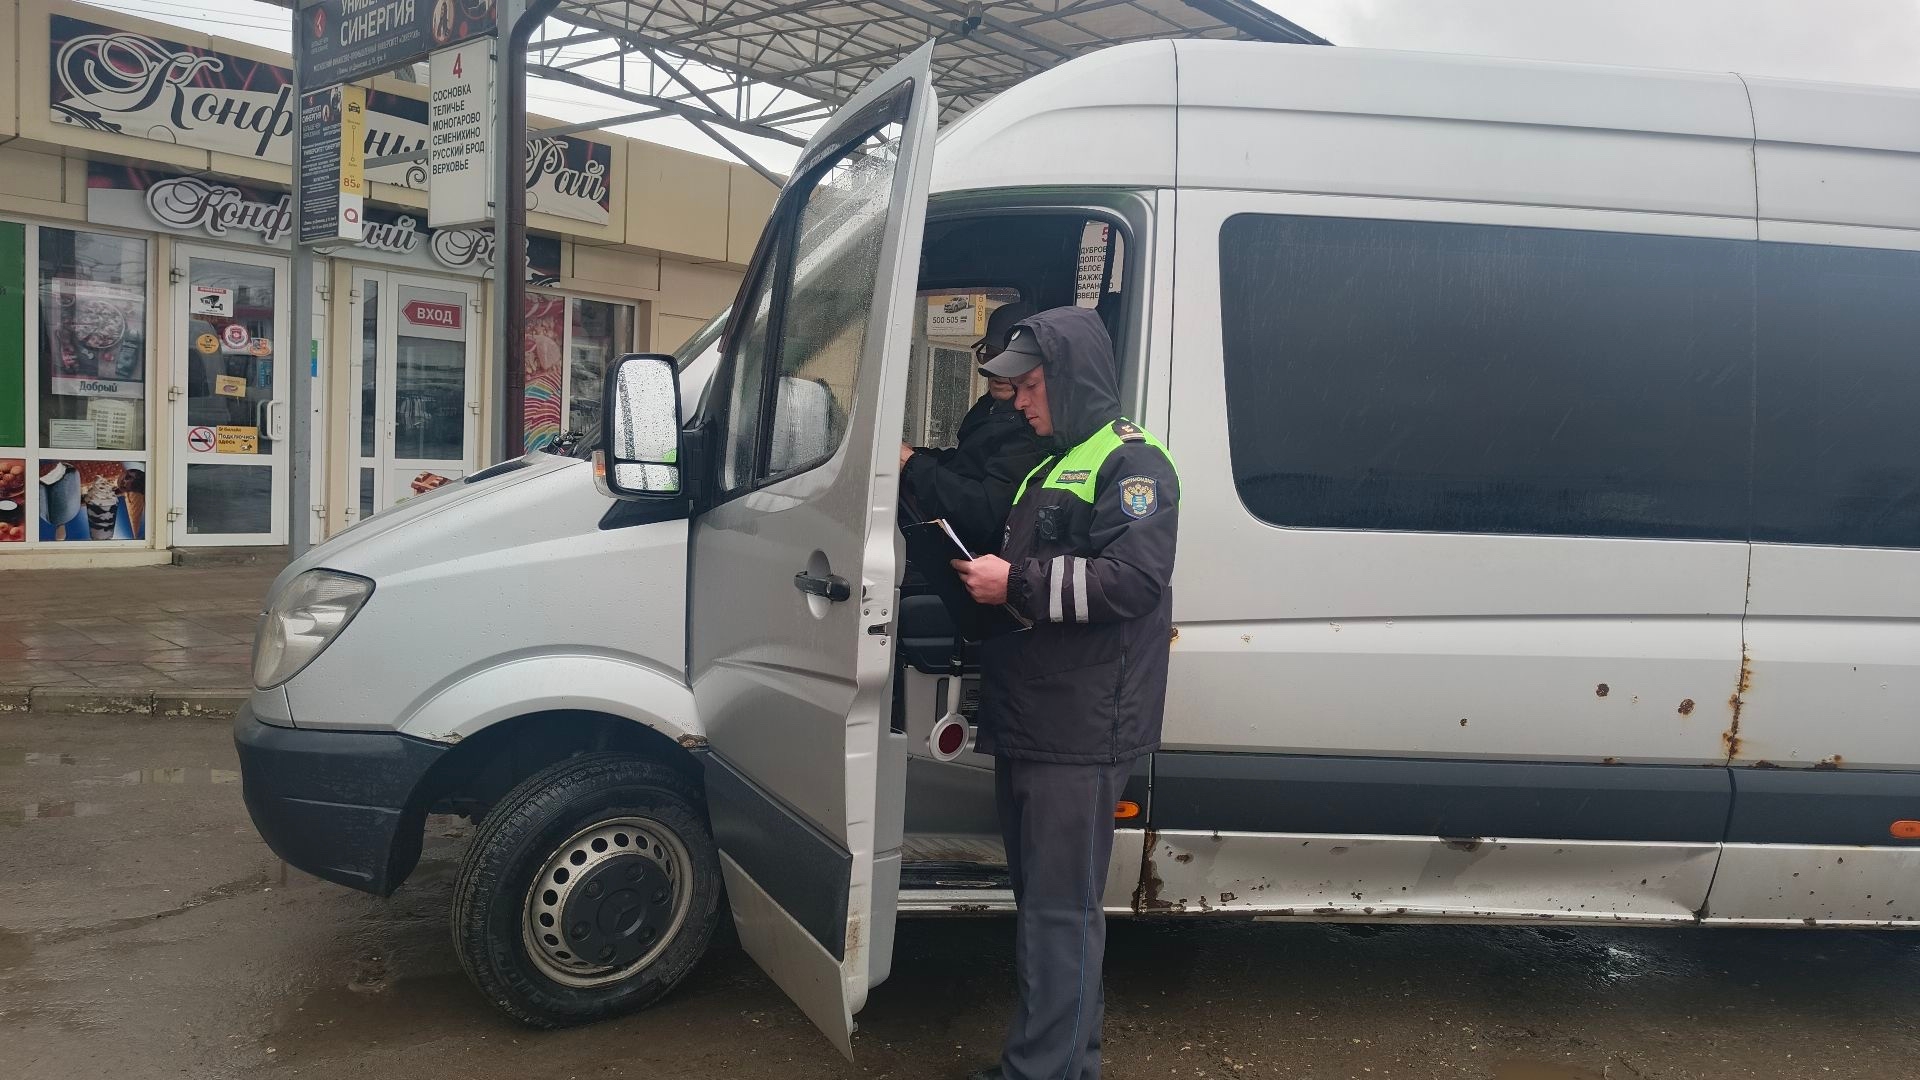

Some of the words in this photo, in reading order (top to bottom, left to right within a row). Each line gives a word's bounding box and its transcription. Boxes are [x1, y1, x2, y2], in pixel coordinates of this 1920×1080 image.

[341, 0, 415, 46] СИНЕРГИЯ
[453, 53, 462, 79] 4
[433, 84, 471, 102] СОСНОВКА
[433, 100, 465, 116] ТЕЛИЧЬЕ
[433, 112, 481, 131] МОНОГАРОВО
[433, 127, 481, 146] СЕМЕНИХИНО
[433, 143, 464, 160] РУССКИЙ
[465, 141, 485, 155] БРОД
[433, 159, 469, 175] ВЕРХОВЬЕ
[526, 137, 606, 201] Рай
[1077, 292, 1100, 300] ВВЕДЕ
[416, 307, 453, 325] ВХОД
[932, 316, 945, 324] 500
[946, 316, 959, 324] 505
[79, 380, 118, 393] Добрый
